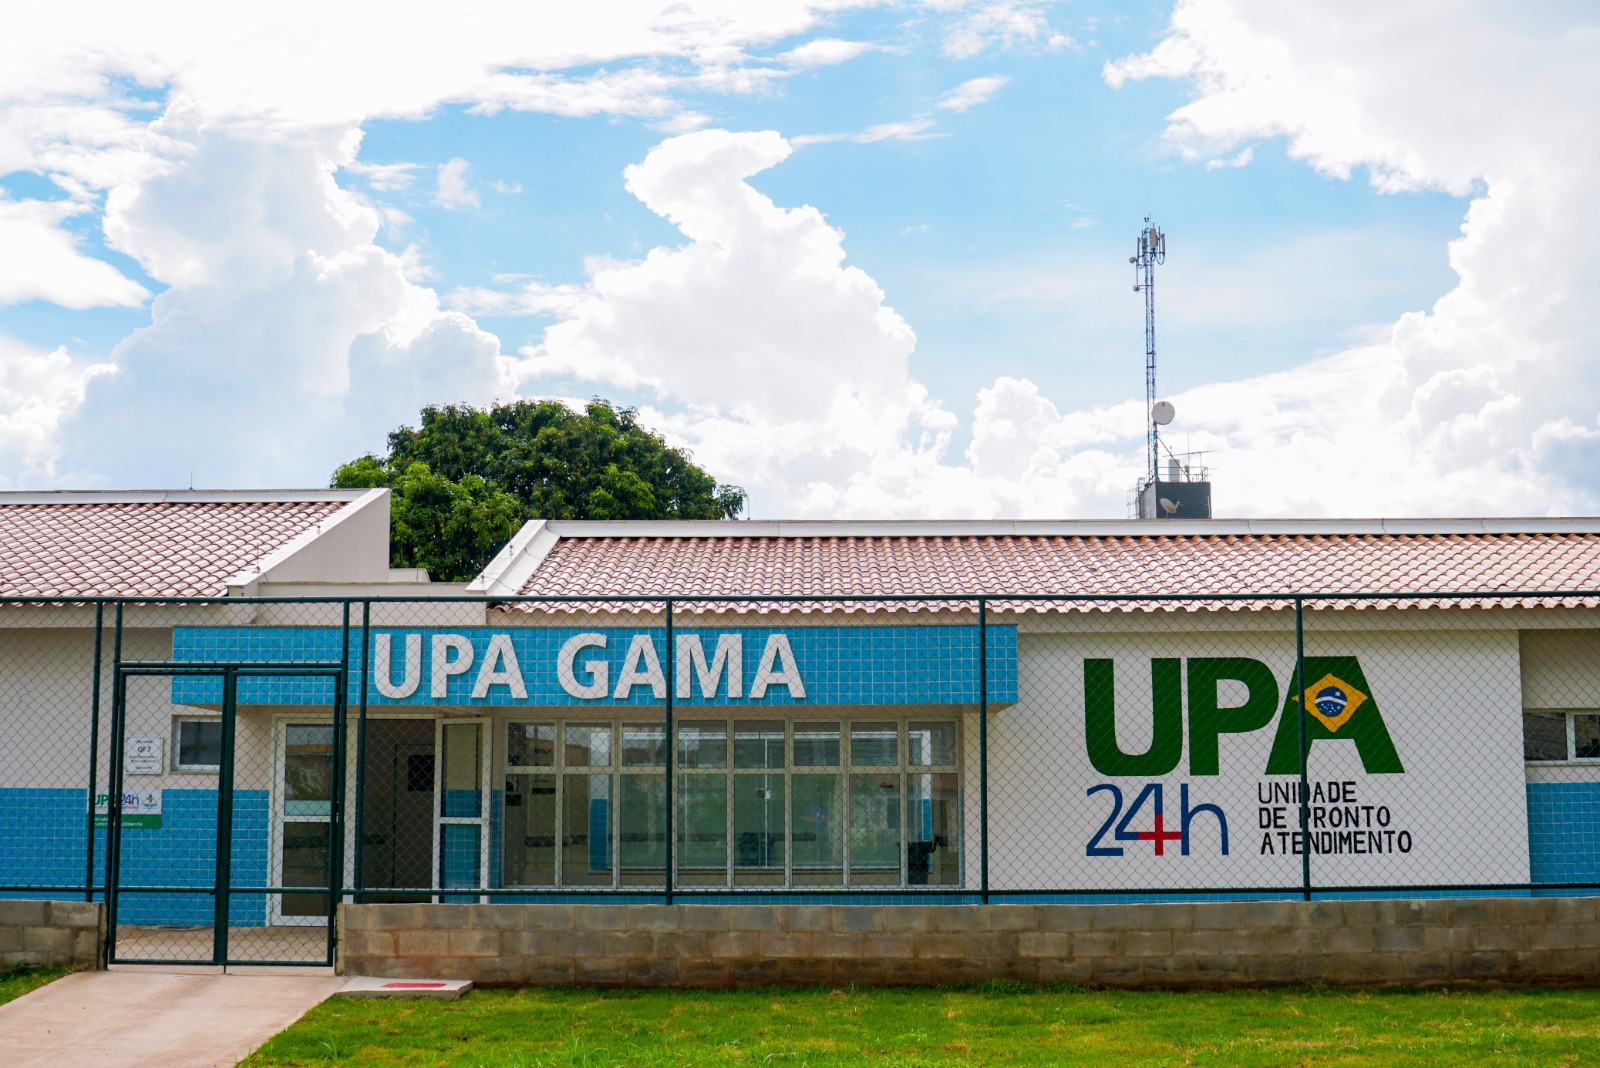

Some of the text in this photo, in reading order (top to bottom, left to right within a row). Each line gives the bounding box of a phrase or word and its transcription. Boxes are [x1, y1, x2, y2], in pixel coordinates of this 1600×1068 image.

[374, 633, 807, 699] UPA GAMA
[1083, 655, 1406, 776] UPA
[1086, 783, 1230, 857] 24h
[1259, 805, 1391, 829] DE PRONTO
[1260, 830, 1413, 856] ATENDIMENTO
